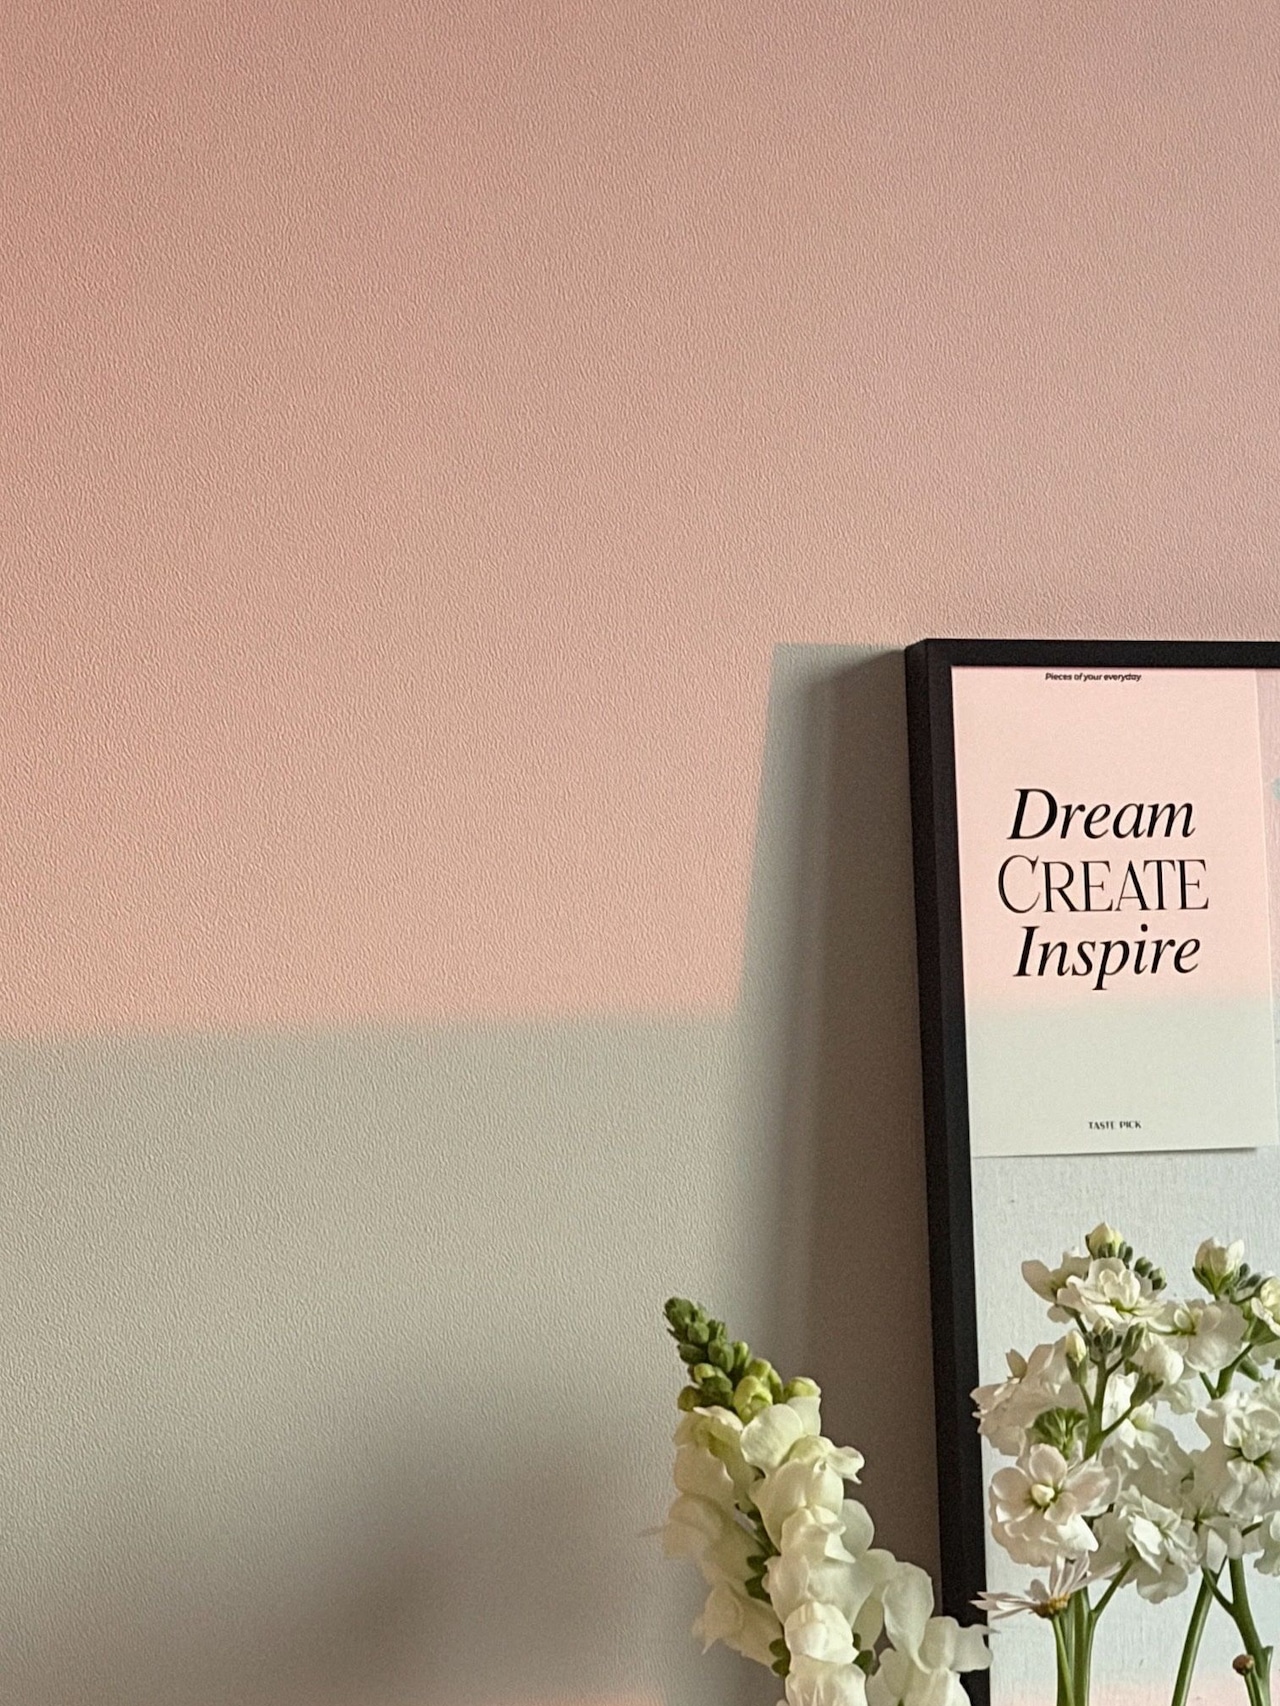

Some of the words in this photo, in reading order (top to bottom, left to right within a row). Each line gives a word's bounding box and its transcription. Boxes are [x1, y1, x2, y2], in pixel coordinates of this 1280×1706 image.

[1045, 672, 1072, 681] Pieces
[1073, 672, 1083, 681] of
[1083, 674, 1102, 682] your
[1103, 672, 1142, 682] everyday
[1006, 788, 1196, 841] Dream
[998, 854, 1210, 914] CREATE
[1012, 924, 1201, 991] Inspire
[1088, 1120, 1115, 1131] TASTE
[1119, 1120, 1142, 1130] PICK
